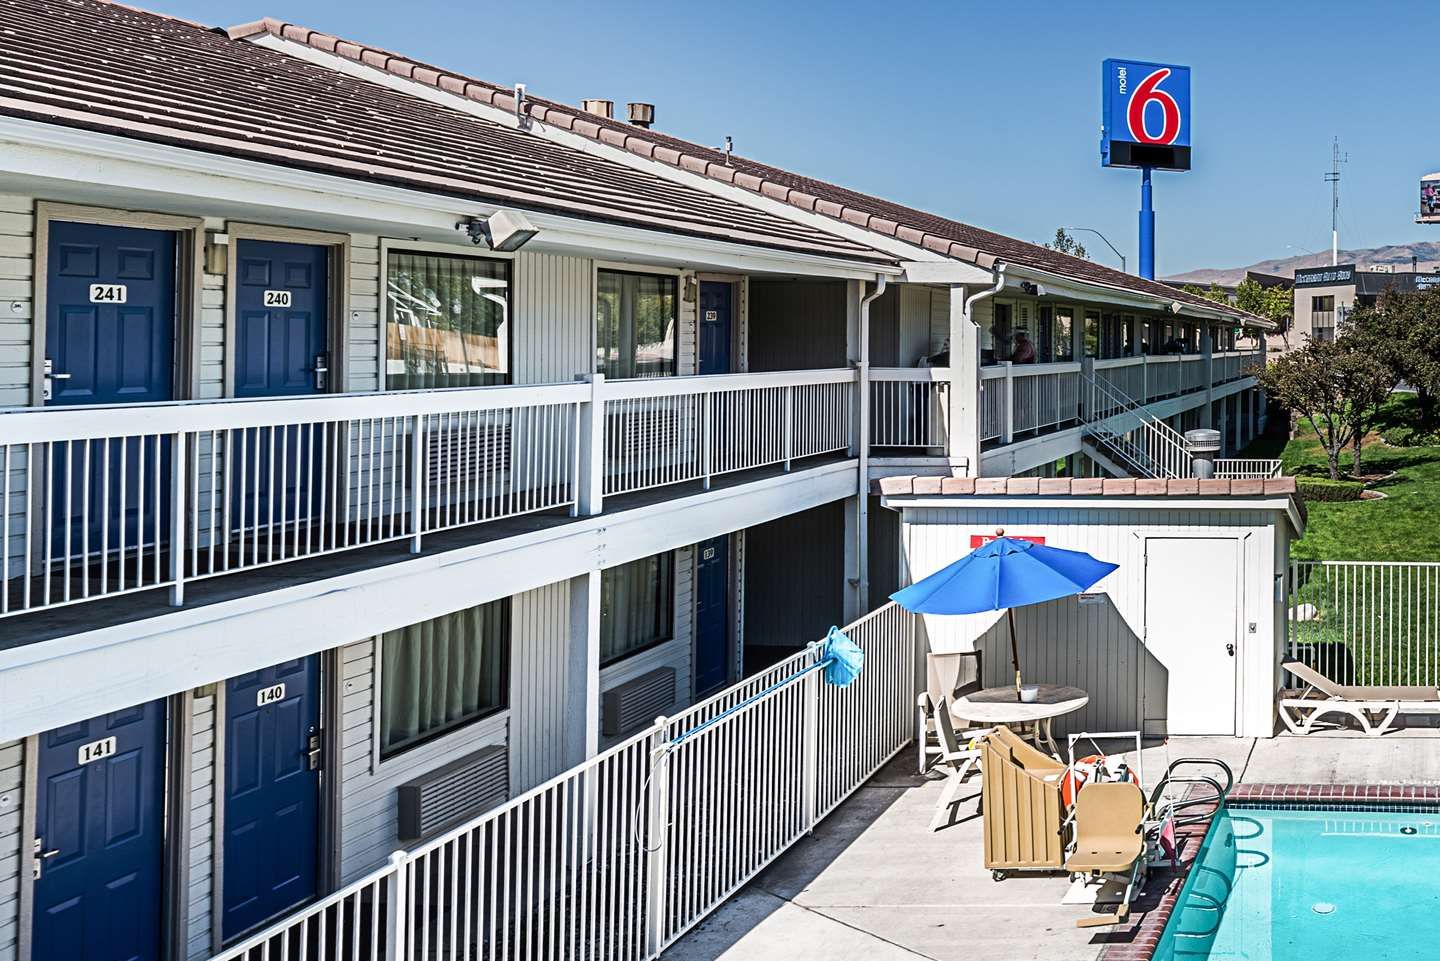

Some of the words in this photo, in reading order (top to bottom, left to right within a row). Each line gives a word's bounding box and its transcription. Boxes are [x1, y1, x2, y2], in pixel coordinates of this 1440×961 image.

[1117, 66, 1127, 95] motel
[1126, 67, 1181, 145] 6
[94, 286, 123, 301] 241
[266, 292, 289, 305] 240
[261, 686, 283, 704] 140
[84, 740, 111, 761] 141
